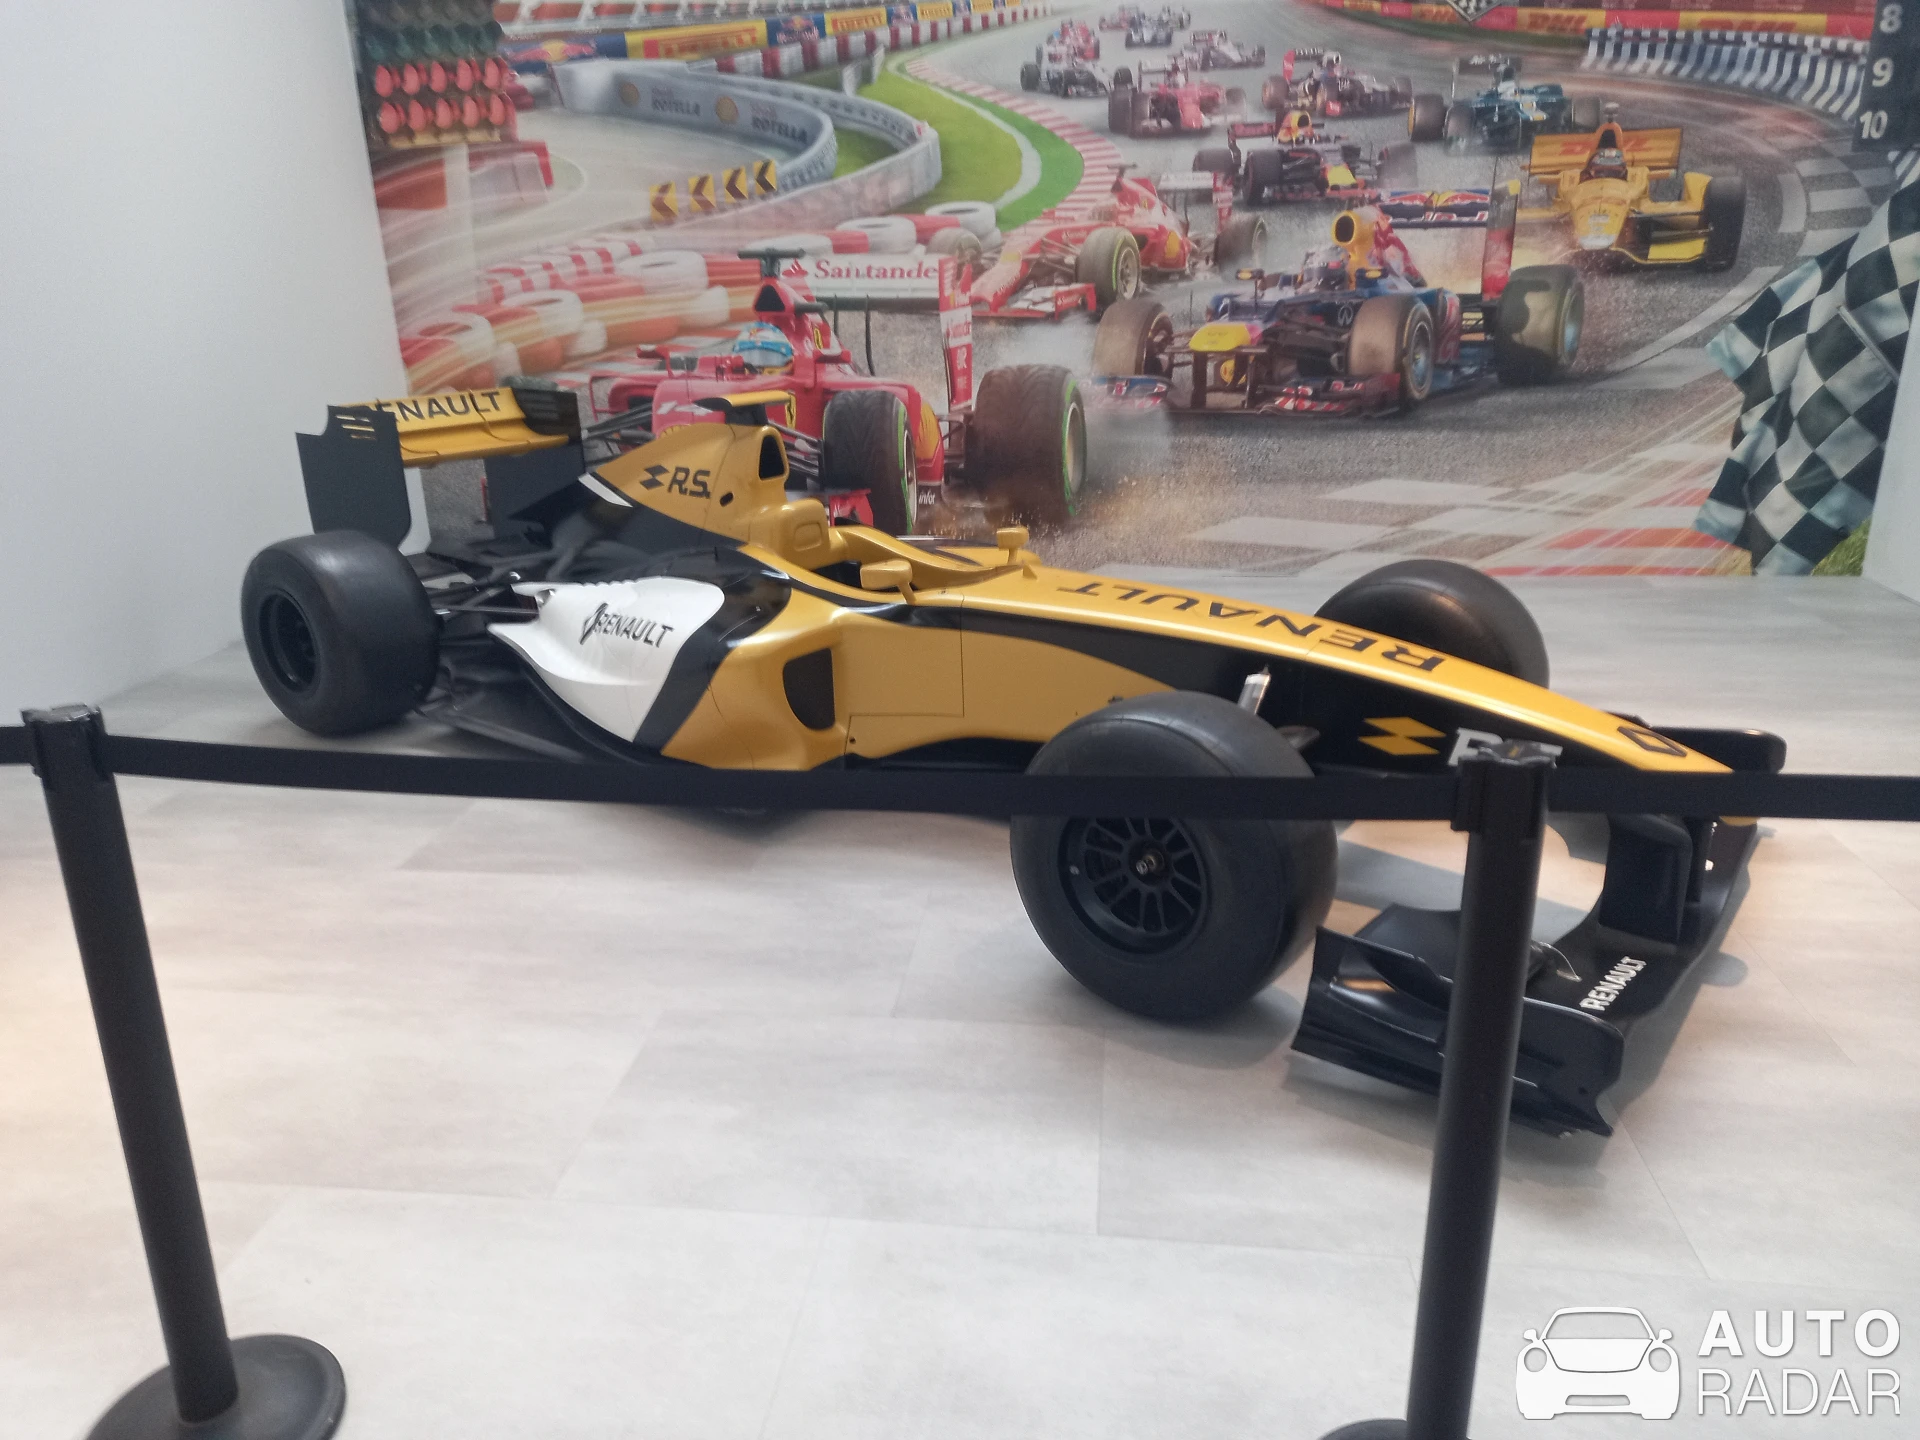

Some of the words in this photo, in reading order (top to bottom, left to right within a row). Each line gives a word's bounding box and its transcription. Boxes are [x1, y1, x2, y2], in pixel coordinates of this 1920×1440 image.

[1880, 4, 1902, 33] 8
[1872, 57, 1894, 87] 9
[1860, 110, 1888, 139] 10
[814, 258, 938, 280] Santande
[375, 391, 502, 422] NAULT
[593, 612, 674, 648] RENAULT
[1057, 581, 1448, 672] RENAULT
[1579, 956, 1647, 1011] RENAULT
